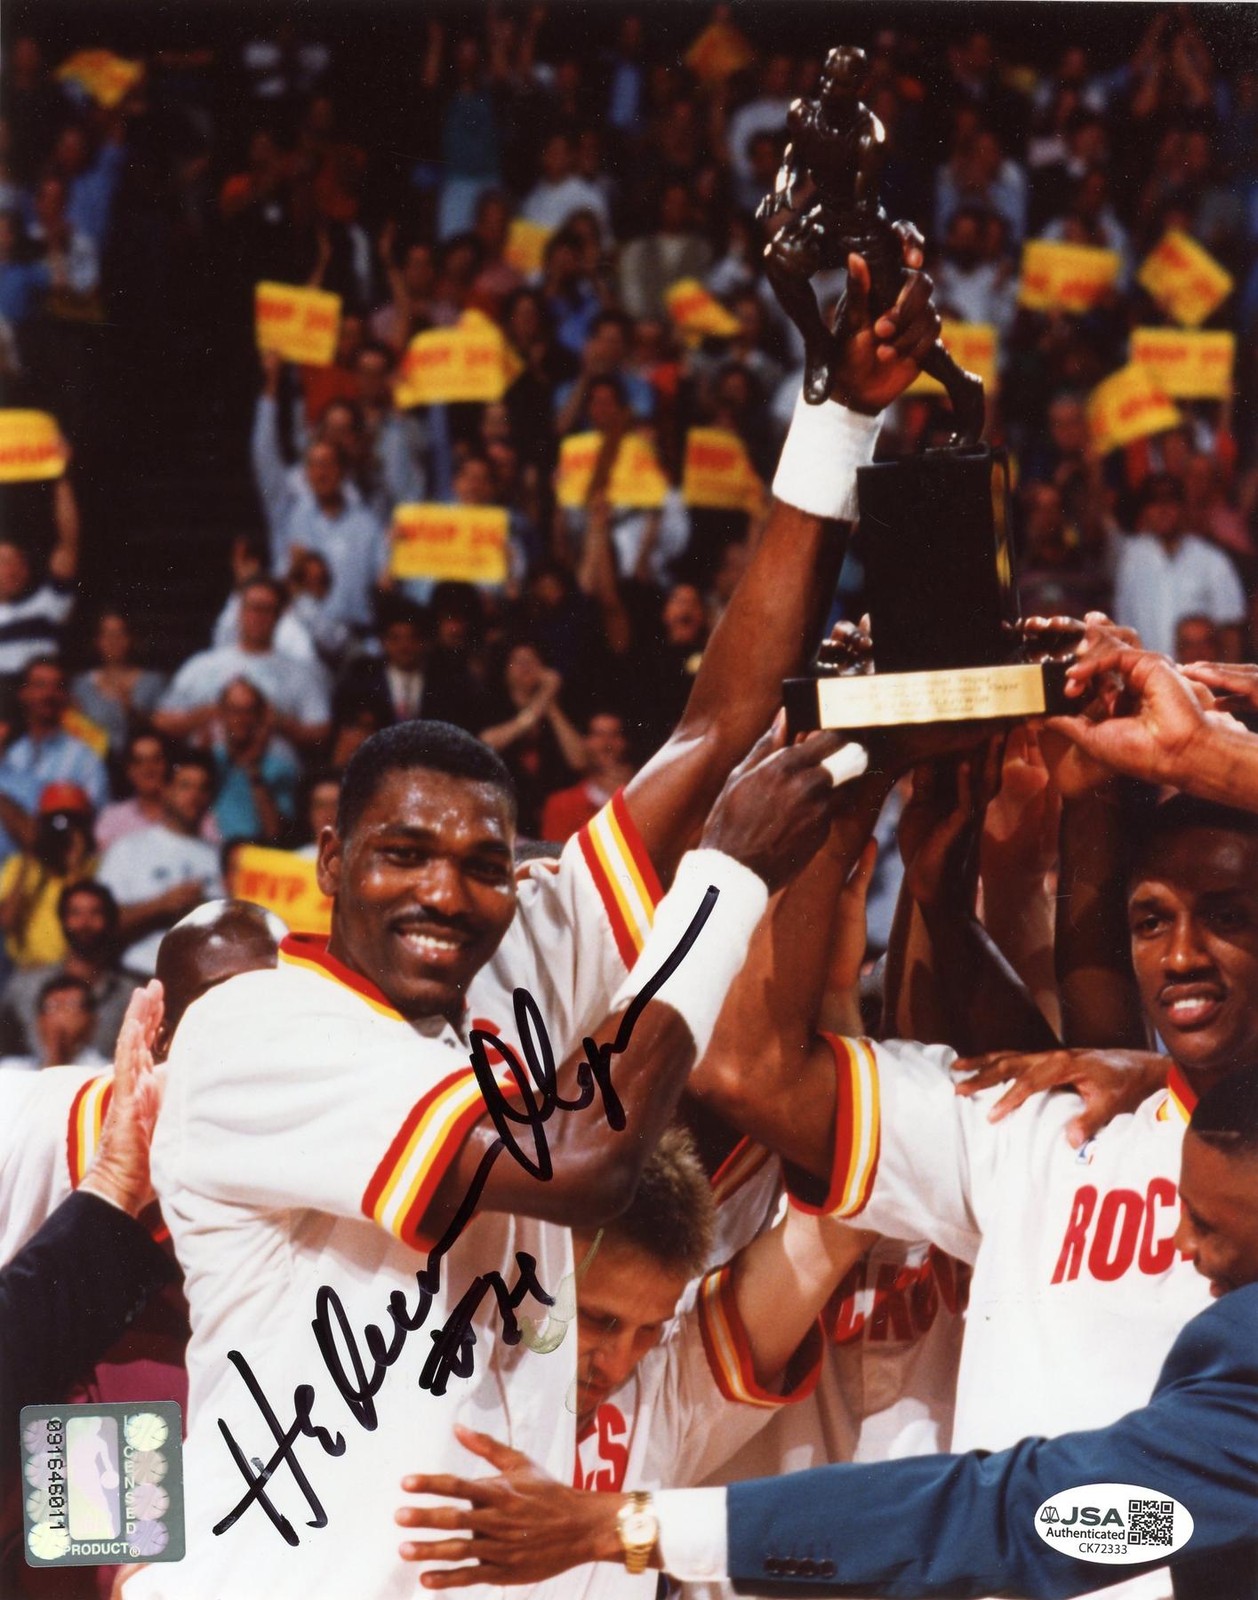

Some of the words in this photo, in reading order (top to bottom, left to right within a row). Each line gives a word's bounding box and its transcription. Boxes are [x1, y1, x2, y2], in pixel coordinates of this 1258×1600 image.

[1051, 1177, 1194, 1286] ROC
[1060, 1506, 1125, 1527] JSA
[1046, 1527, 1126, 1540] Authenticated
[1078, 1543, 1128, 1555] CK72333
